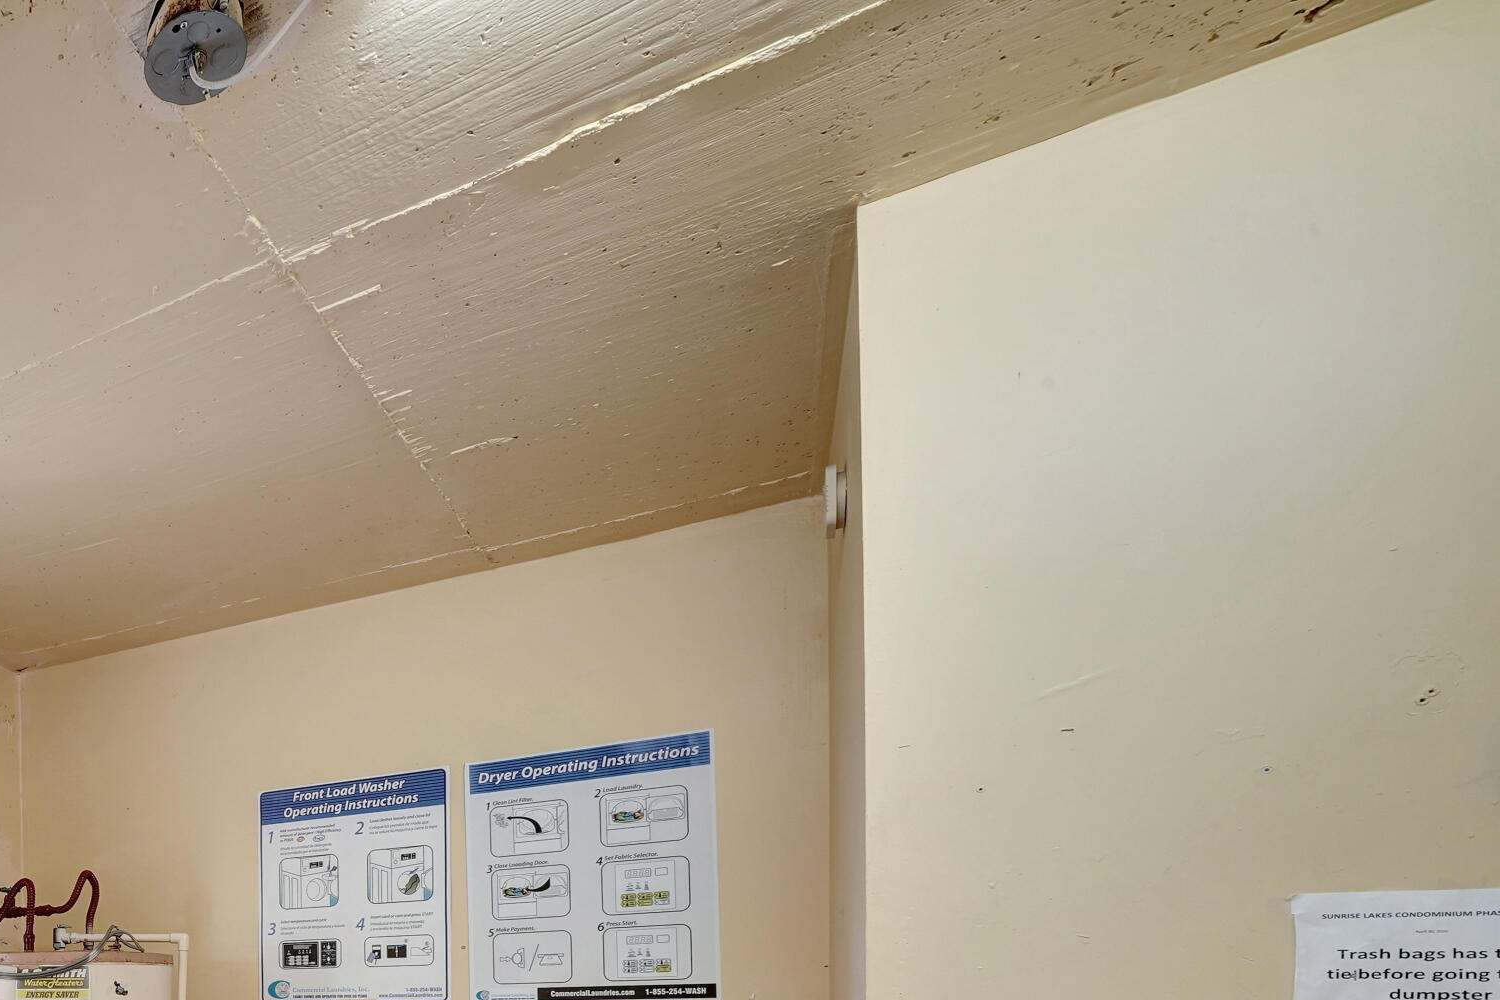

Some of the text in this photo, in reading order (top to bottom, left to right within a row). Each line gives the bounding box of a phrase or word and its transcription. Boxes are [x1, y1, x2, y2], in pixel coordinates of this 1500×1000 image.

[478, 744, 699, 786] Dryer Operating Instructions
[293, 778, 405, 802] Front Load Washer
[594, 789, 601, 798] 2
[284, 793, 418, 819] Operating Instructions
[355, 822, 364, 835] 2
[268, 831, 274, 844] 1
[596, 857, 602, 865] 4
[487, 865, 492, 873] 3
[268, 922, 276, 935] 3
[356, 918, 365, 931] 4
[598, 923, 604, 931] 6
[488, 929, 494, 937] 5
[1337, 948, 1488, 961] Trash bags has
[1359, 968, 1490, 982] before going
[48, 979, 84, 988] Heaters
[550, 987, 706, 998] CommercialLaundries.com 1-855-254-WASH
